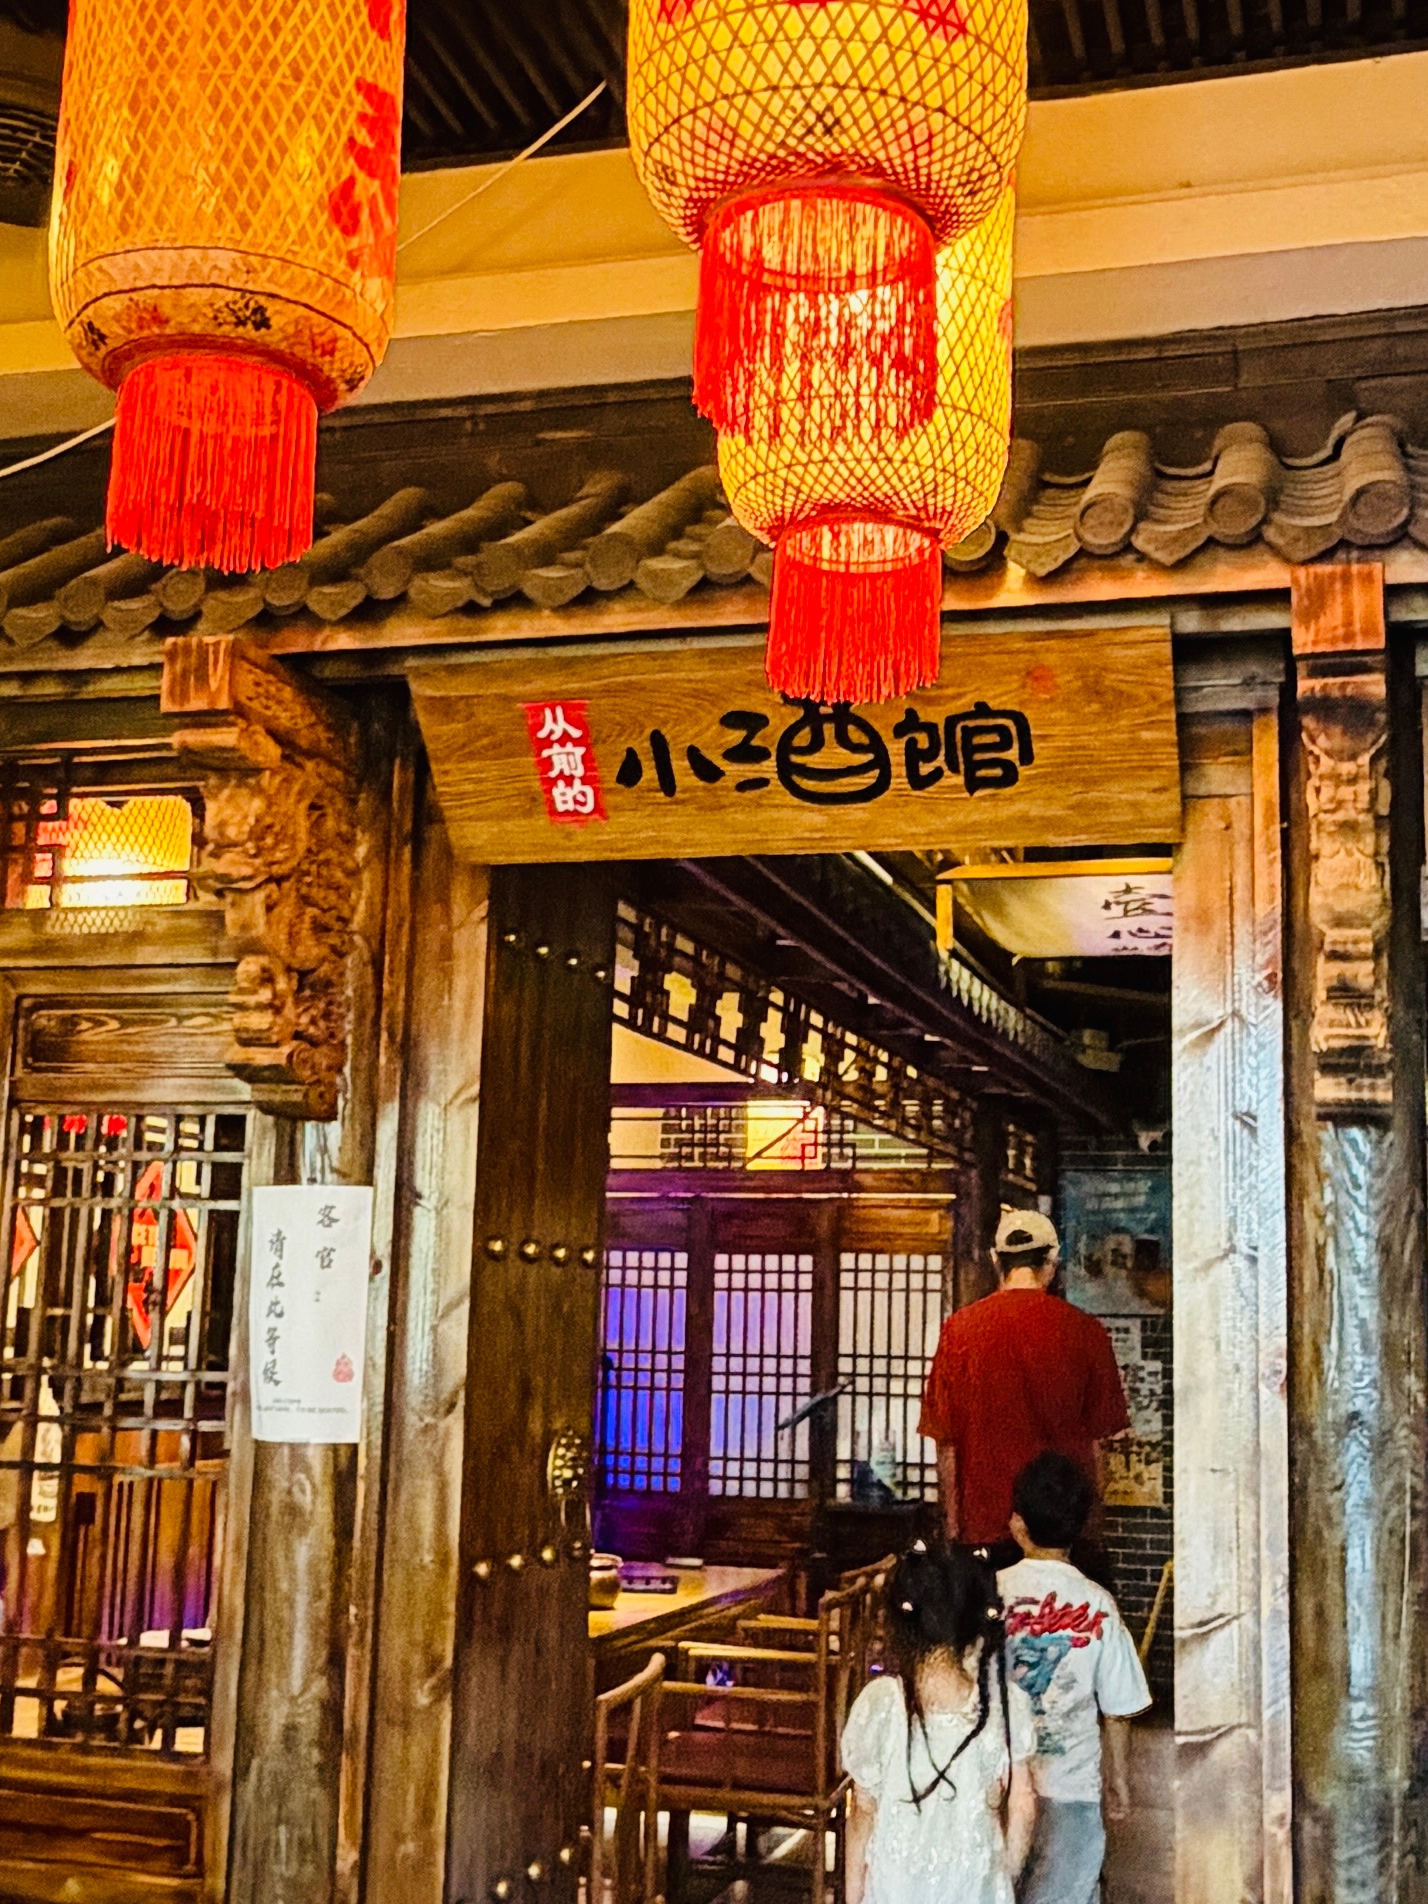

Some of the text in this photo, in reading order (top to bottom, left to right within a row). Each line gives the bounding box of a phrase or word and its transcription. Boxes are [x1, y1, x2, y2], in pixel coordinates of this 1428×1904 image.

[536, 705, 594, 814] 从前的
[616, 699, 1033, 805] 小酒馆
